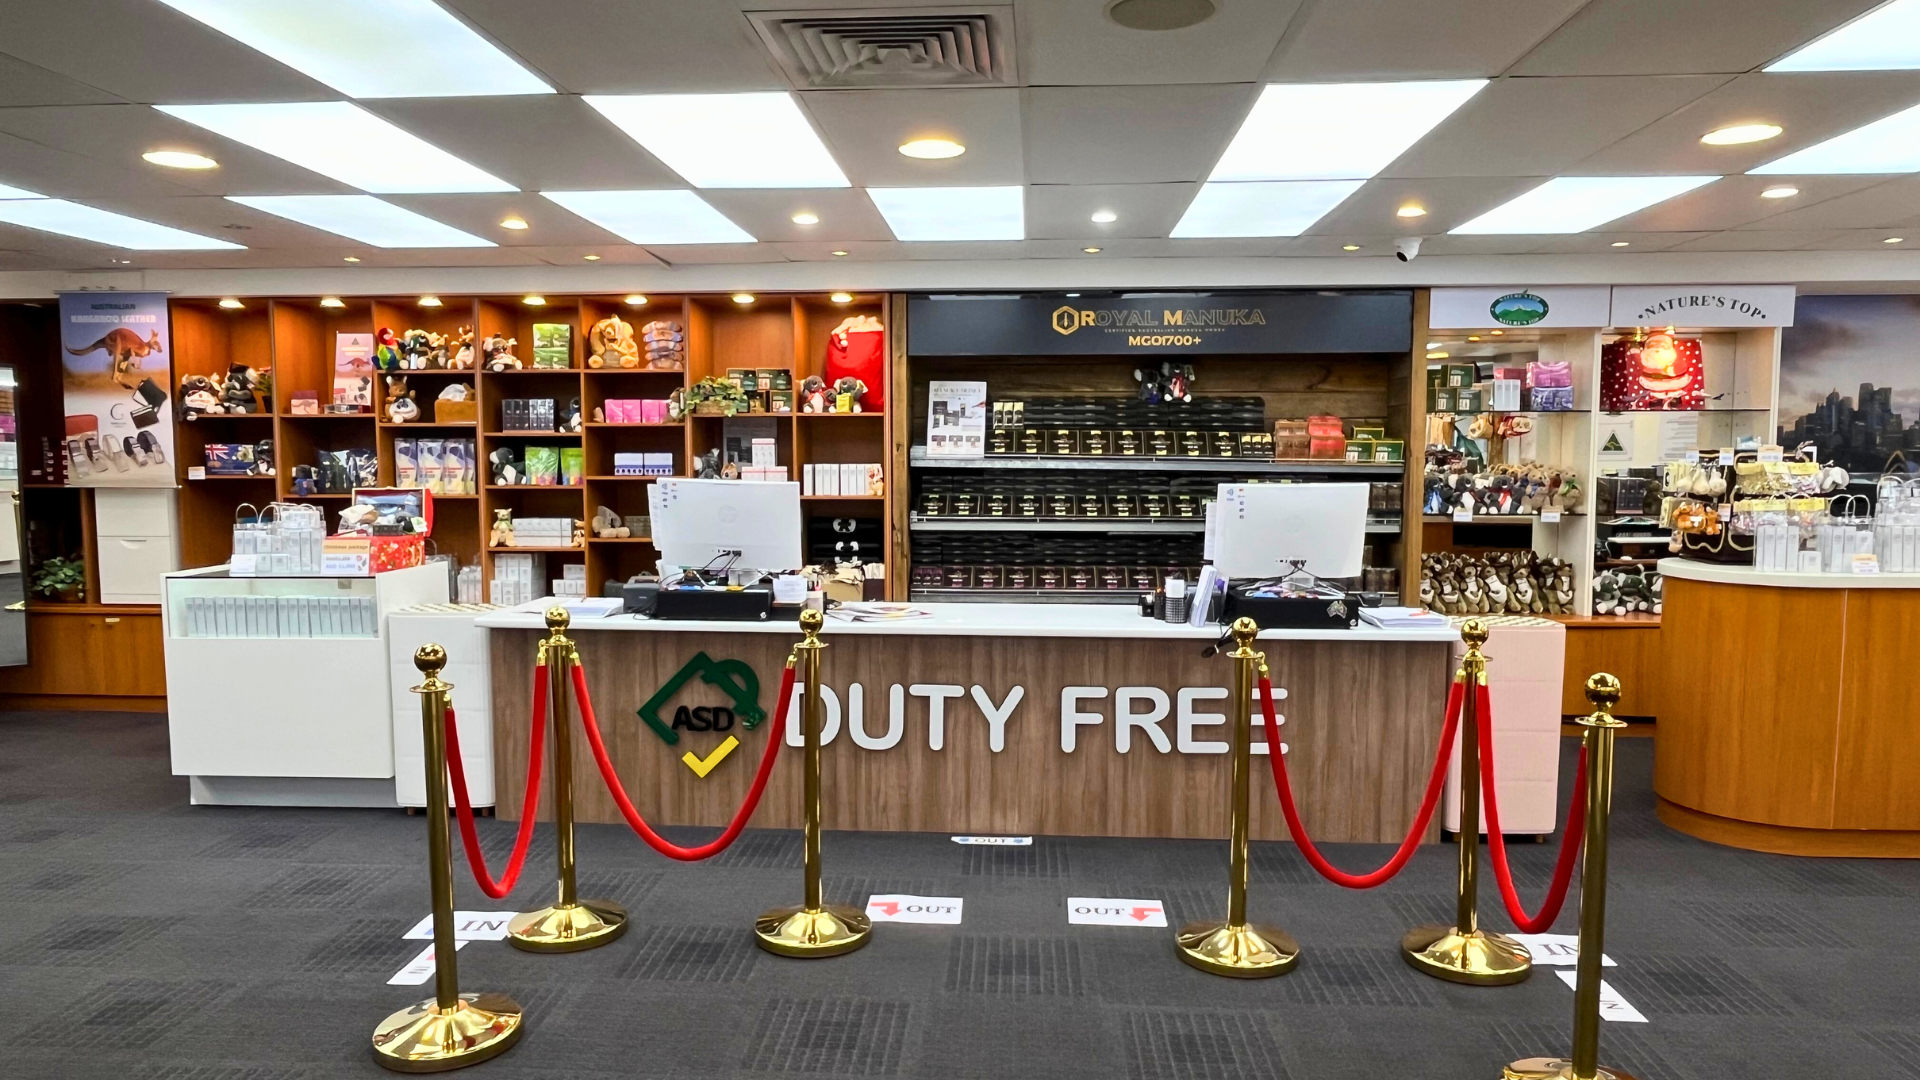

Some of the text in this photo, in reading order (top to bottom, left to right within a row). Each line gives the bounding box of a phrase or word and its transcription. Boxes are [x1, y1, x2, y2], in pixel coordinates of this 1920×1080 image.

[1645, 295, 1762, 319] NATURE'S TOP
[121, 314, 157, 323] LEATHER
[1080, 309, 1266, 326] ROYAL MANUKA
[671, 705, 735, 732] ASD
[785, 682, 1025, 753] DUTY
[906, 905, 957, 914] OUT
[1074, 906, 1126, 915] OUT
[458, 920, 508, 931] IN
